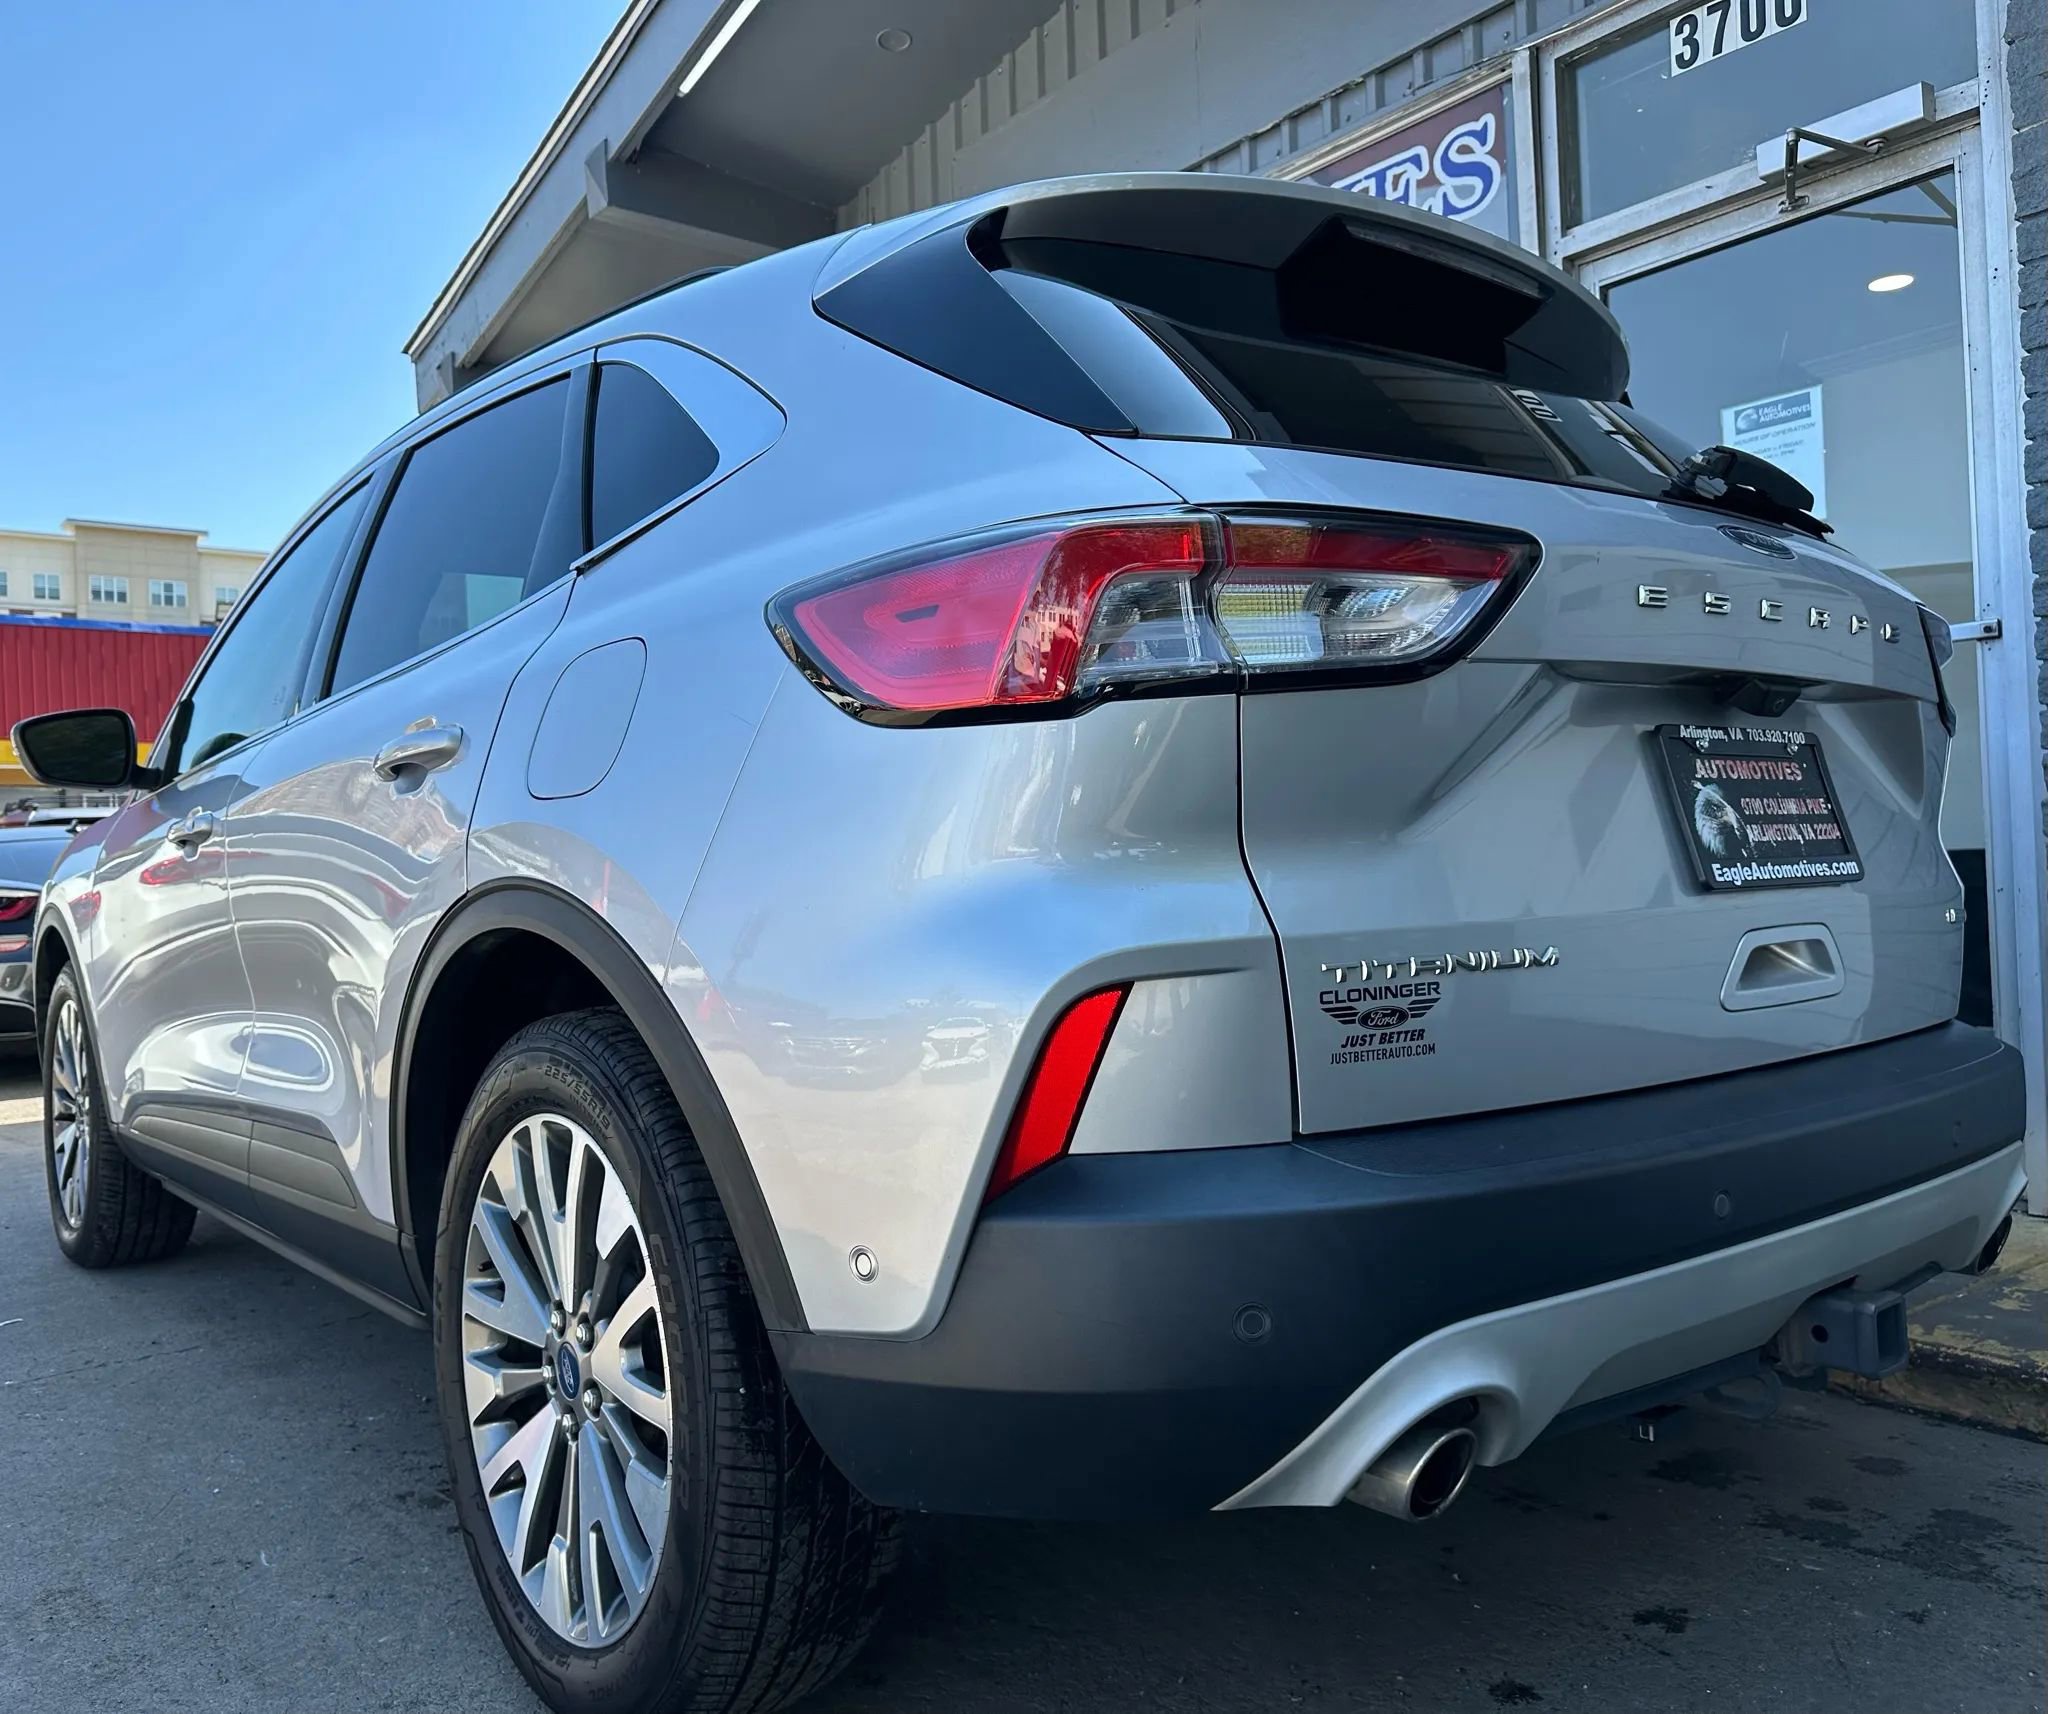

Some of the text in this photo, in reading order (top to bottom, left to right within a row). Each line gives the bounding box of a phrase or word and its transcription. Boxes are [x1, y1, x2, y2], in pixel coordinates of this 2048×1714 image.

[1680, 724, 1806, 744] Arlington, VA 703.920.7100
[1695, 759, 1803, 781] AUTOMOTIVES
[1800, 824, 1816, 840] VA
[1712, 860, 1860, 886] EagleAutomotives.com
[1321, 946, 1560, 984] TITANIUM
[1319, 981, 1441, 1005] CLONINGER
[1366, 1009, 1399, 1027] Ford
[1341, 1028, 1426, 1049] JUST BETTER
[1330, 1043, 1436, 1065] JUSTBETTERAUTO.COM
